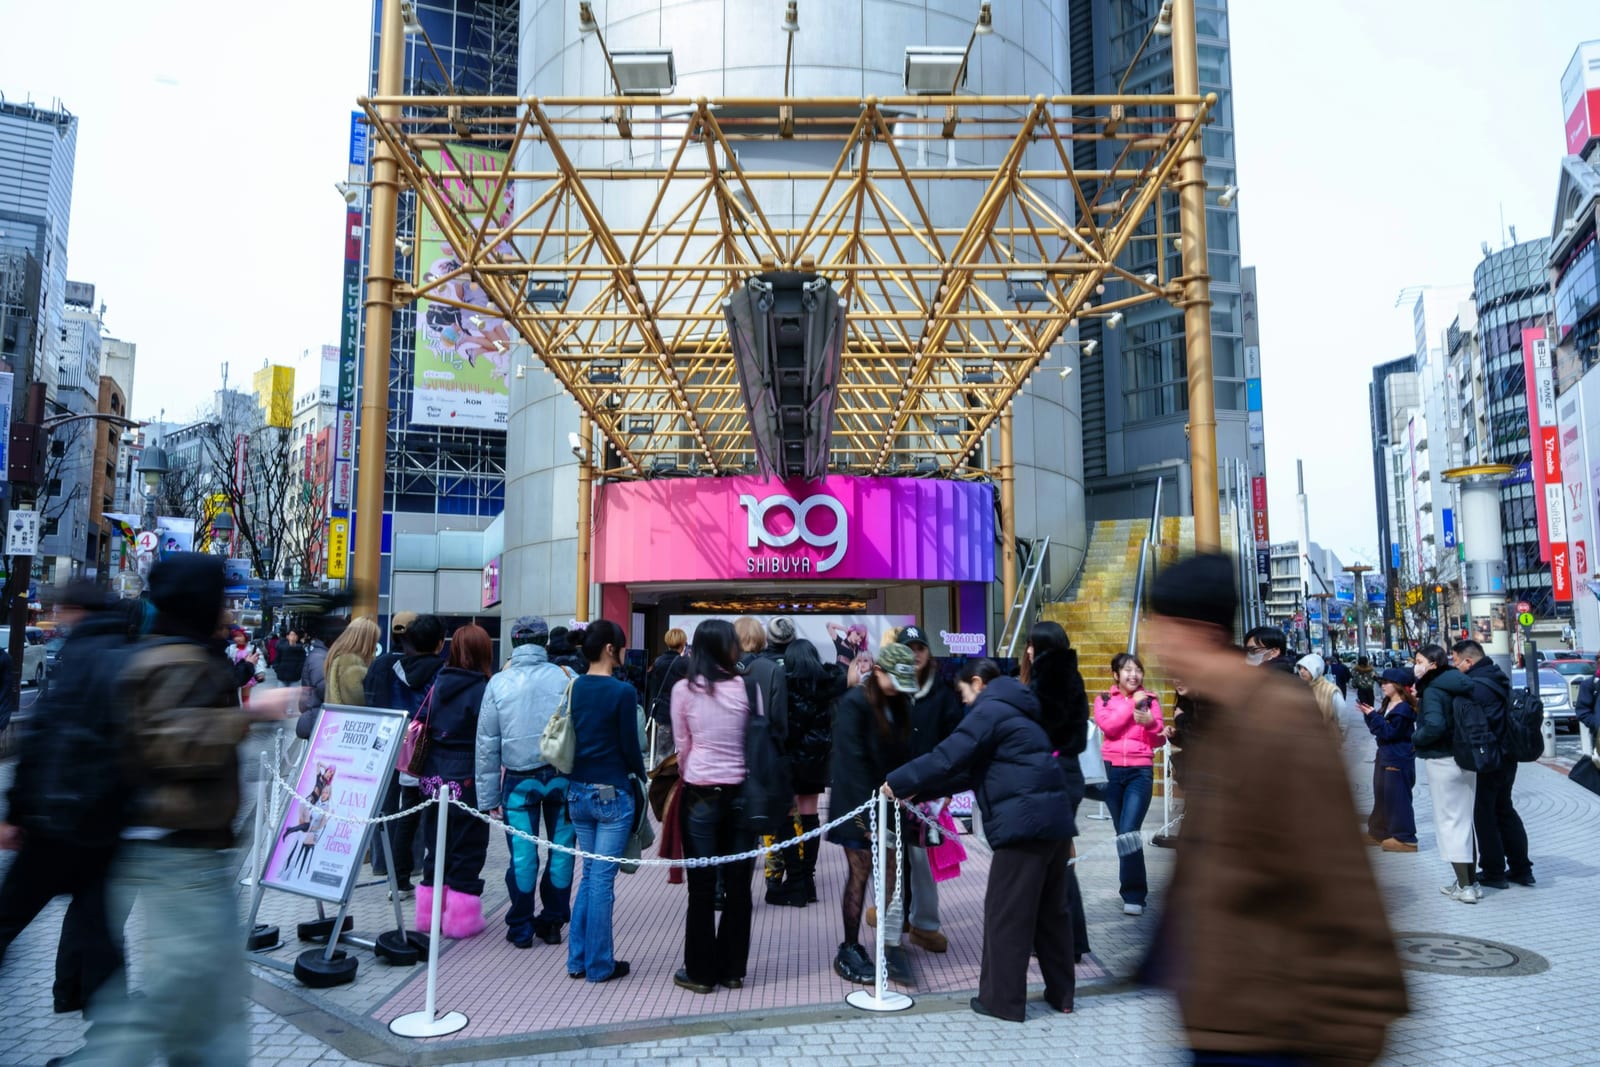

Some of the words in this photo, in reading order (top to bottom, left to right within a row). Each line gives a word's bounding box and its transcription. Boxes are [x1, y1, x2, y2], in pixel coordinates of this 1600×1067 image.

[1543, 379, 1553, 409] DANCE
[342, 419, 352, 451] カラオケ
[1550, 499, 1561, 538] SoftBank
[141, 535, 151, 548] 4
[739, 494, 848, 573] 109
[747, 556, 810, 573] SHIBUYA
[342, 720, 376, 734] RECEIPT
[341, 732, 369, 745] PHOTO
[339, 790, 368, 809] LANA
[324, 835, 352, 855] Teresa
